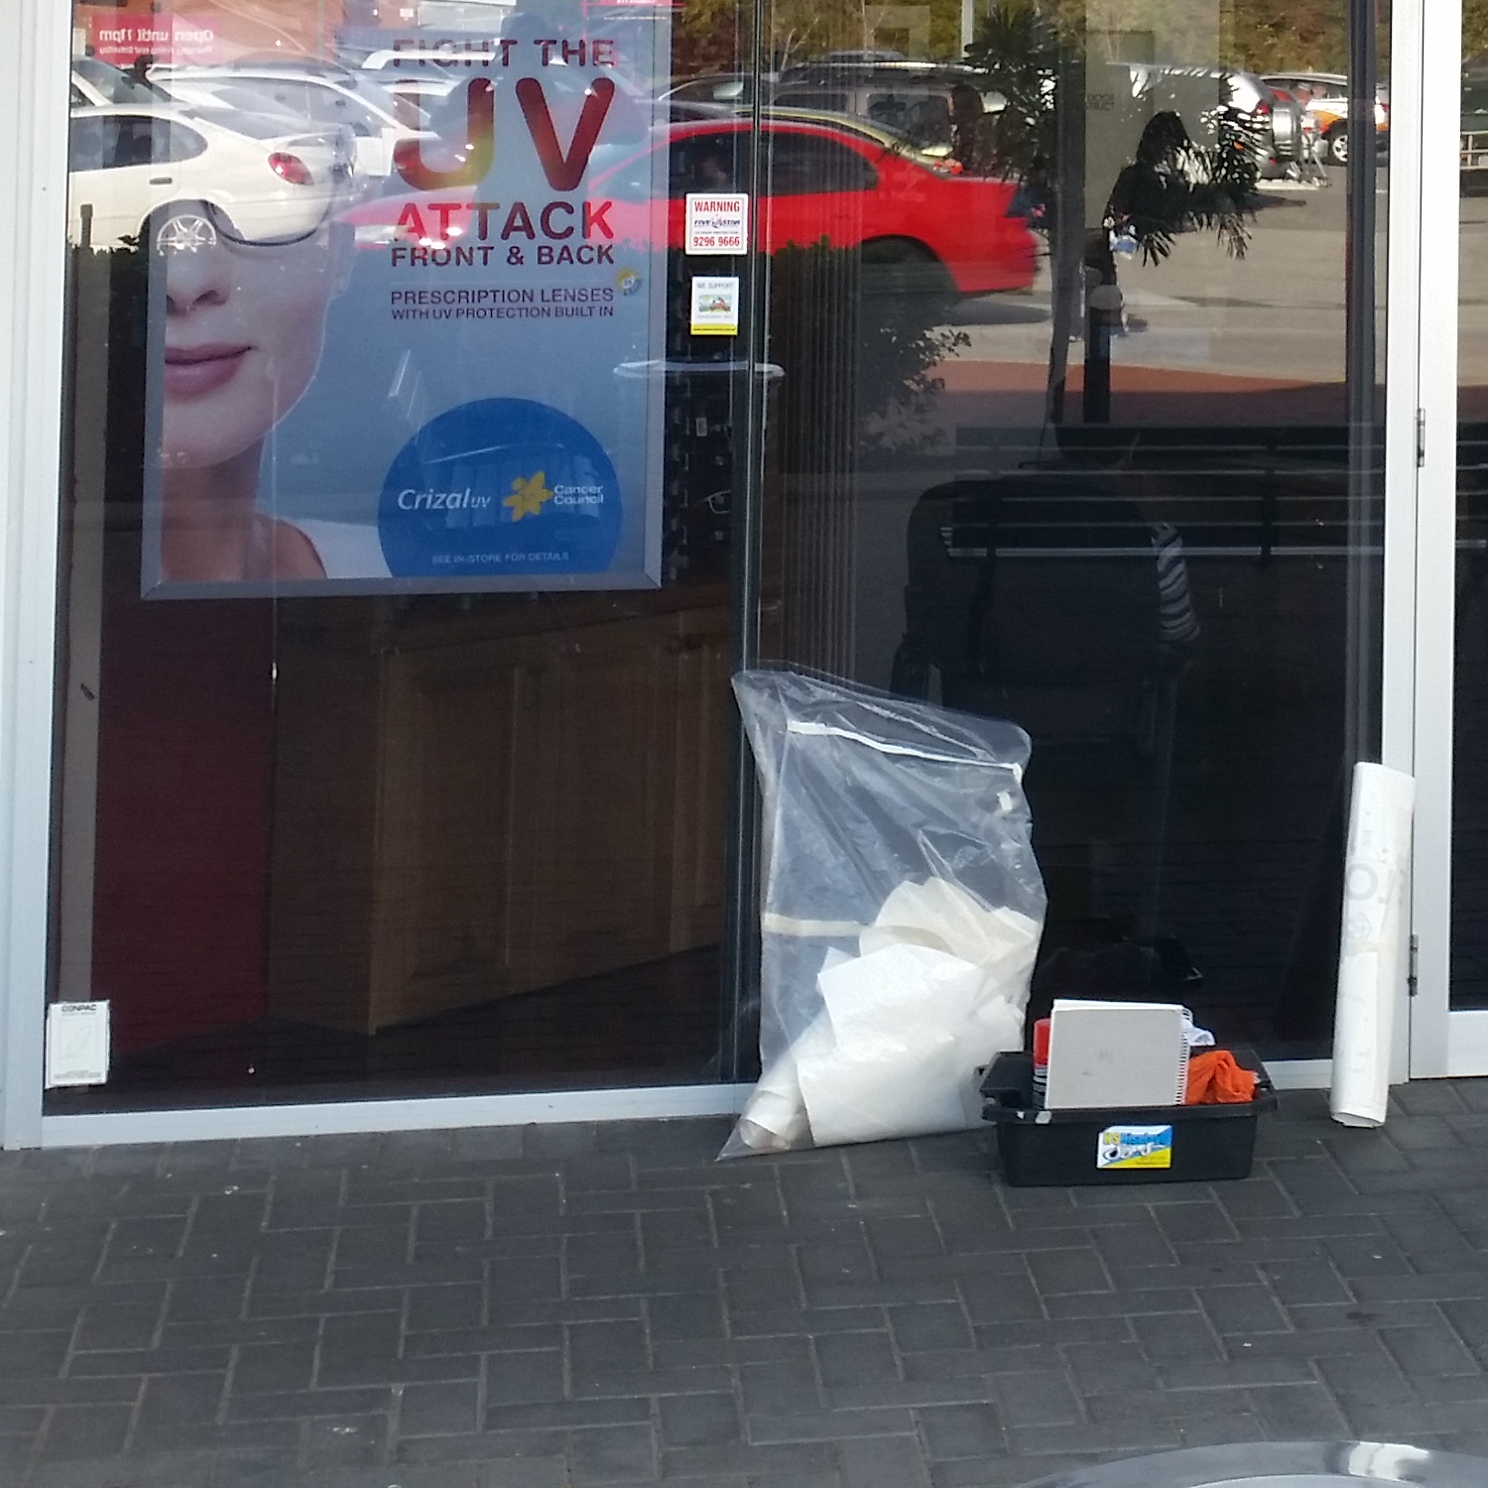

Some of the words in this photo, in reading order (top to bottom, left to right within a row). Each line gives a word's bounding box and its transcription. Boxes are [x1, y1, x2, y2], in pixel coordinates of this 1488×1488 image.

[393, 38, 518, 67] FIGHT
[533, 38, 615, 67] THE
[393, 77, 616, 192] UV
[694, 200, 740, 212] WARNING
[394, 200, 615, 242] ATTACK
[693, 235, 715, 247] 9296
[717, 236, 740, 247] 9666
[391, 246, 495, 267] FRONT
[506, 245, 524, 266] &
[537, 244, 615, 265] BACK
[391, 288, 535, 305] PRESCRIPTION
[541, 287, 614, 303] LENSES
[391, 308, 430, 320] WITH
[432, 308, 451, 319] UV
[456, 306, 553, 319] PROTECTION
[555, 306, 597, 318] BUILT
[599, 305, 614, 317] IN
[553, 484, 604, 495] Cancer
[397, 488, 471, 510] Crizal
[553, 494, 604, 506] Council
[432, 555, 450, 564] SEE
[453, 553, 500, 564] IN-STORE
[505, 553, 526, 562] FOR
[528, 551, 570, 562] DETAILS
